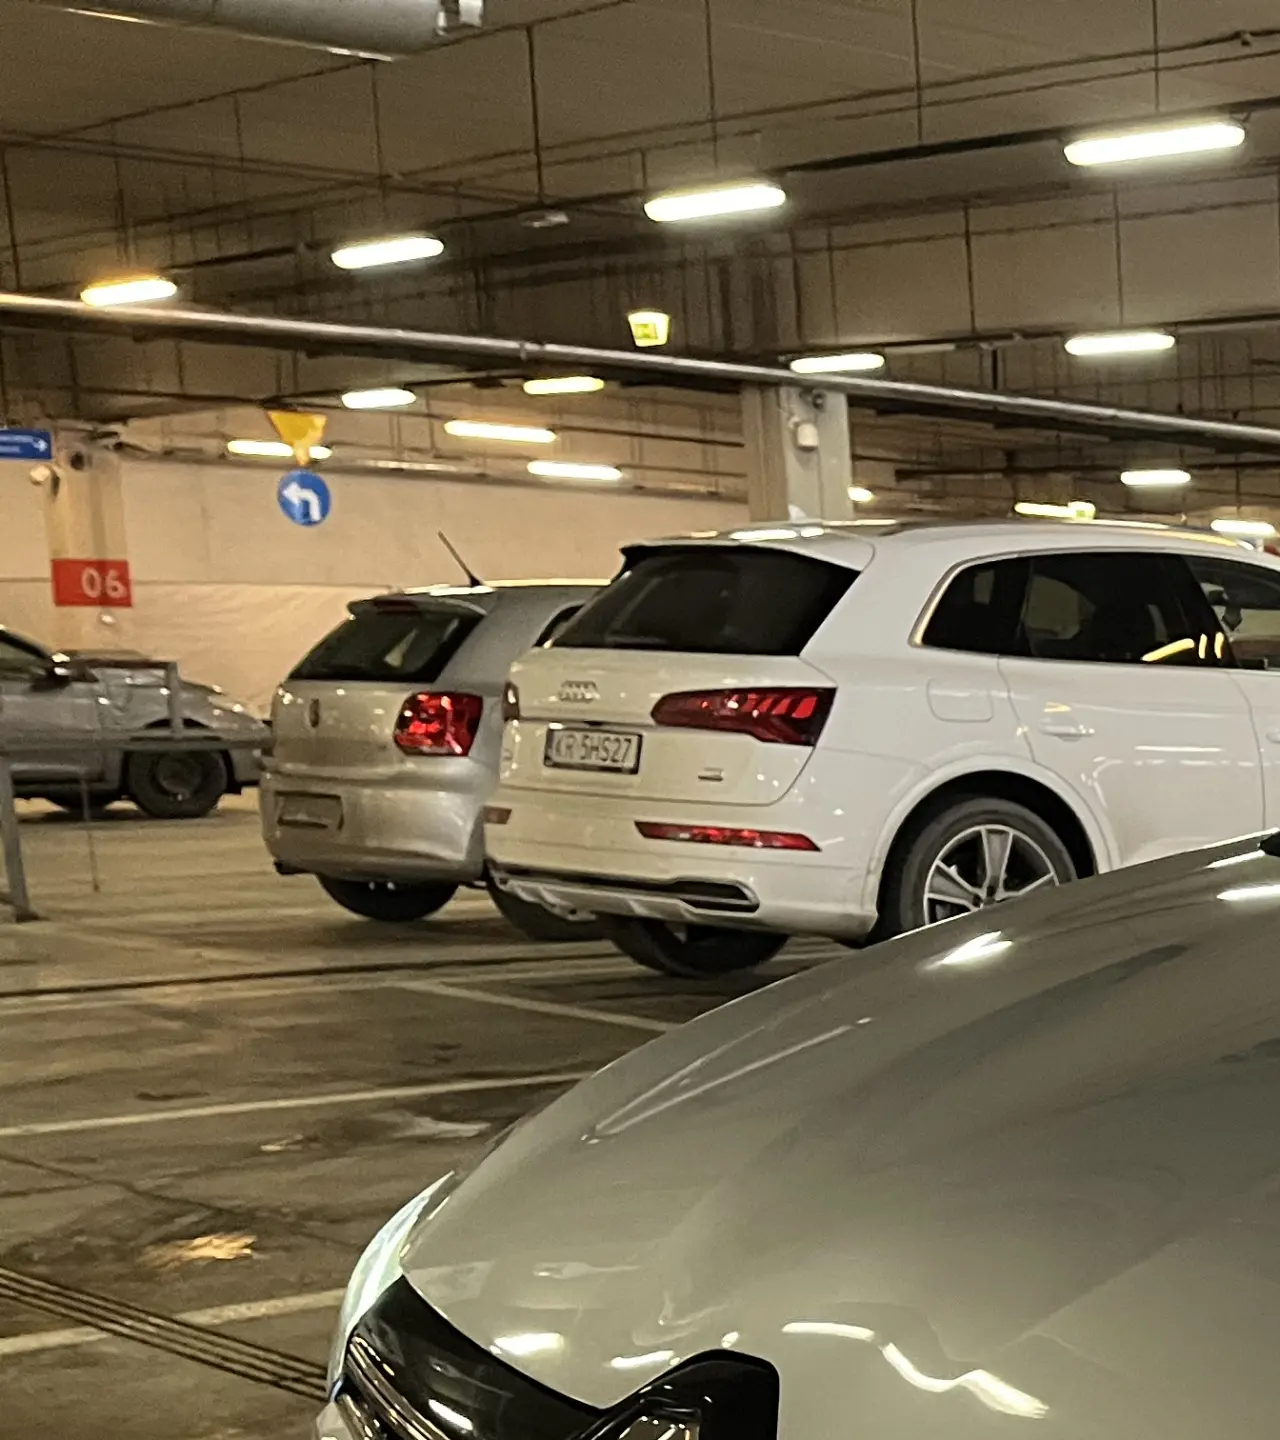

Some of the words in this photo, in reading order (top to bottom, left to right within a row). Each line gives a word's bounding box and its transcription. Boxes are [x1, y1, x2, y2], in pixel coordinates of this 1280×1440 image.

[81, 566, 128, 599] 06
[555, 734, 577, 760] KR
[579, 735, 632, 763] 5HS27
